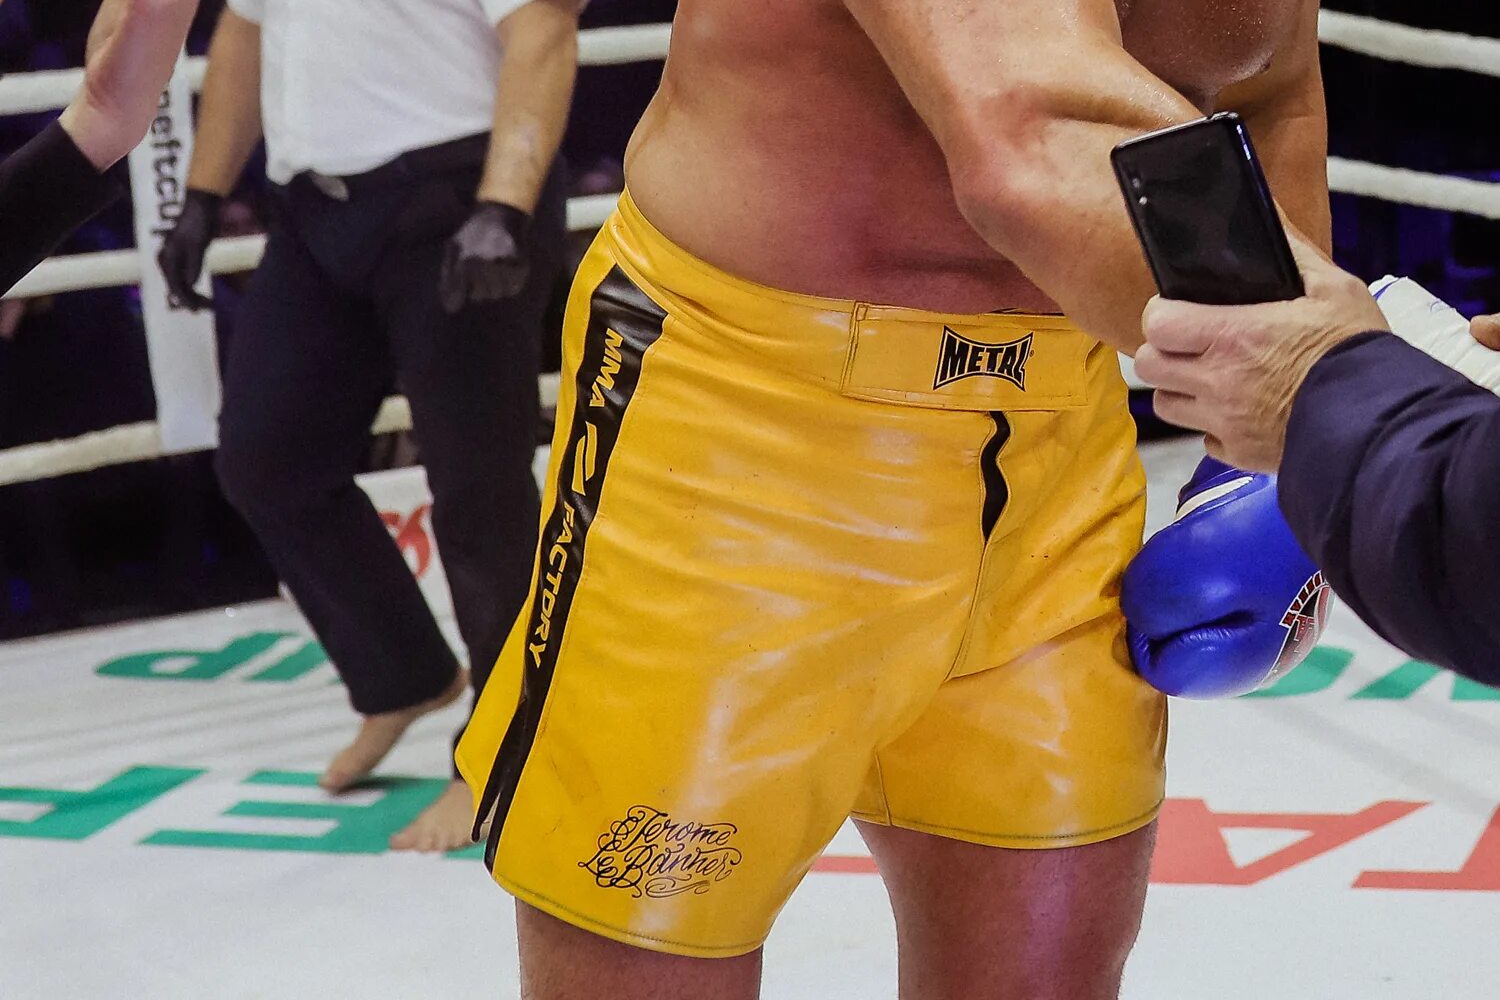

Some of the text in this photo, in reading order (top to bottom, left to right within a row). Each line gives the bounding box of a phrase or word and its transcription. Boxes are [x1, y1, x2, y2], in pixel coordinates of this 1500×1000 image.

[938, 331, 1031, 384] METAL
[529, 327, 624, 670] MMA FACTORY
[610, 804, 738, 853] Jerome
